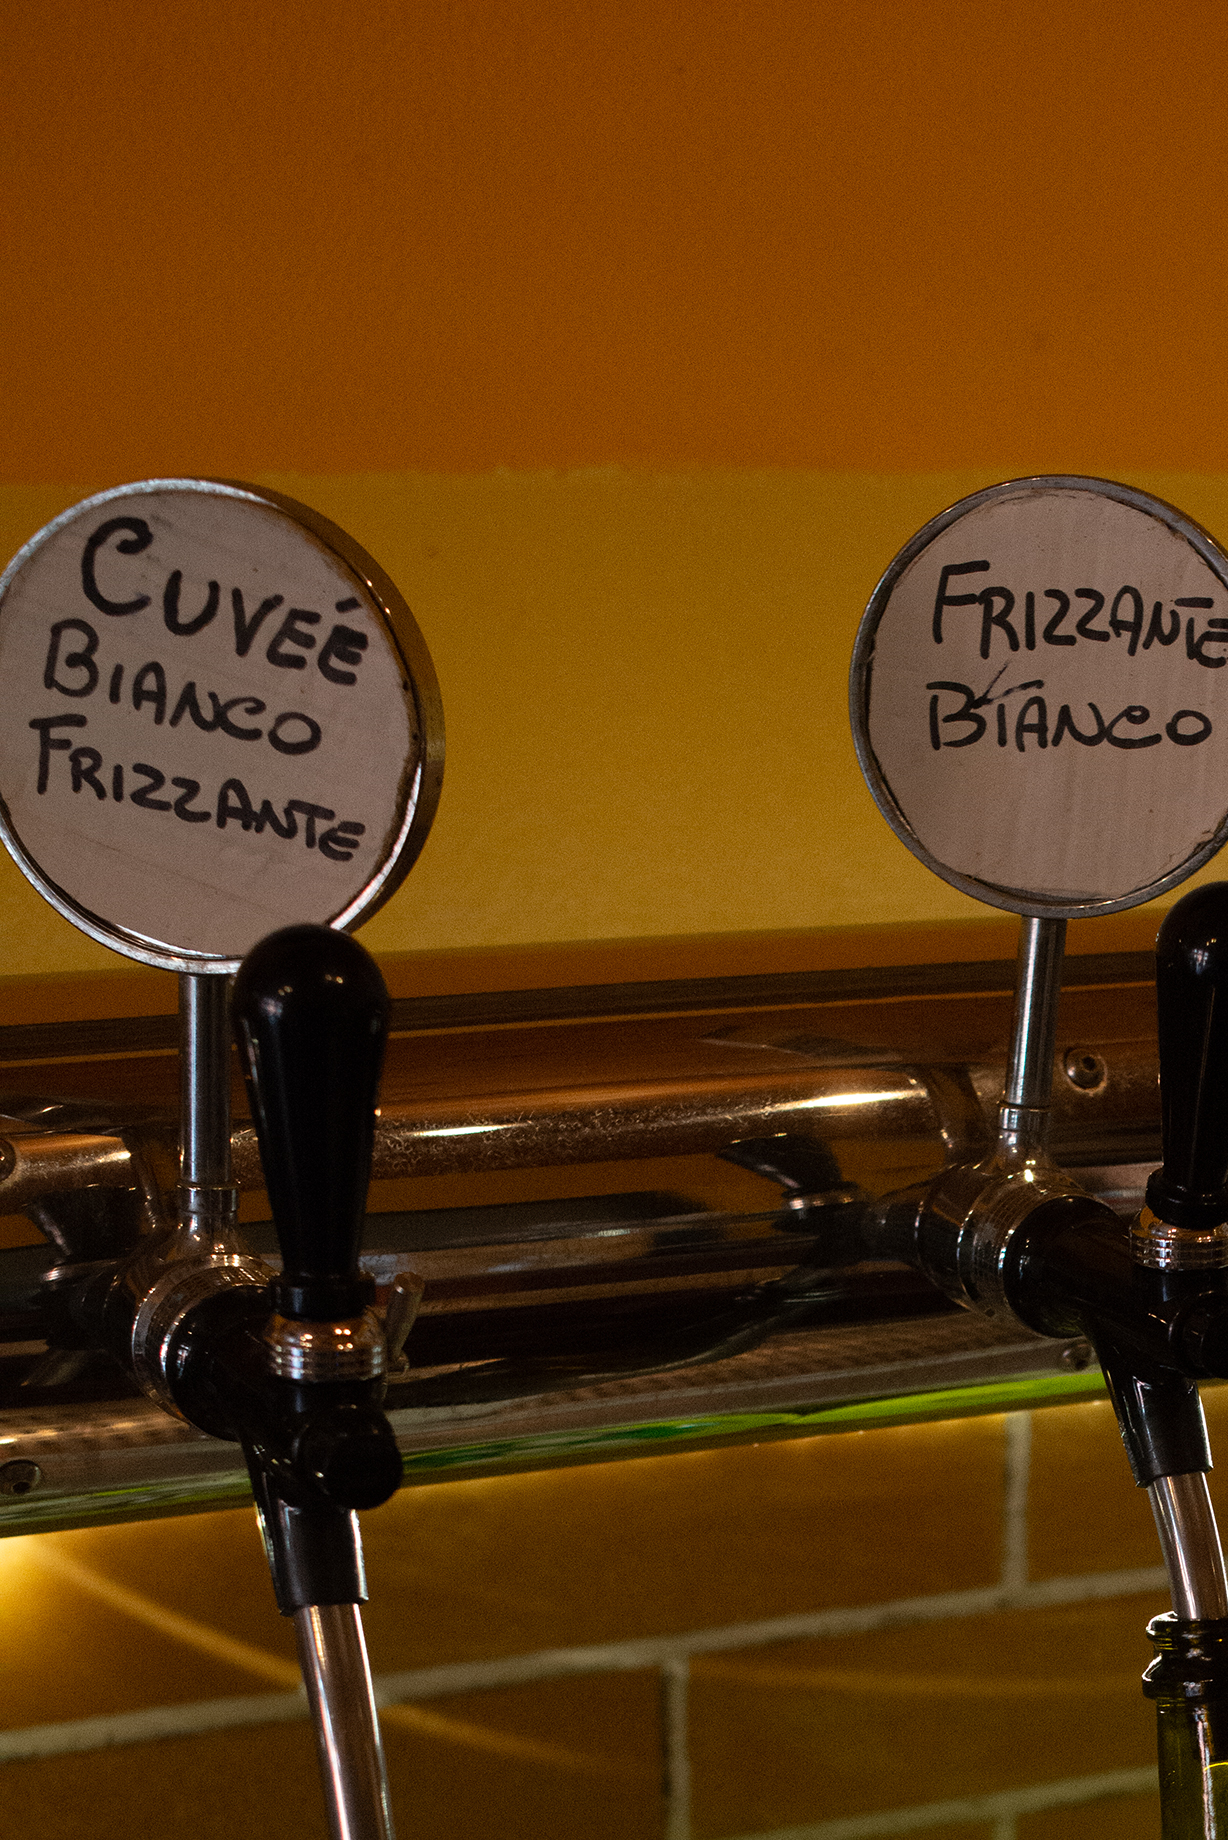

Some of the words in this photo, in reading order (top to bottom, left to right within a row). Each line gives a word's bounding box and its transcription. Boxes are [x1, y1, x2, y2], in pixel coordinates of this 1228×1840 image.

[44, 618, 322, 756] BIANCO
[926, 679, 1213, 753] BIANCO
[29, 714, 366, 862] FRIZZANTE
